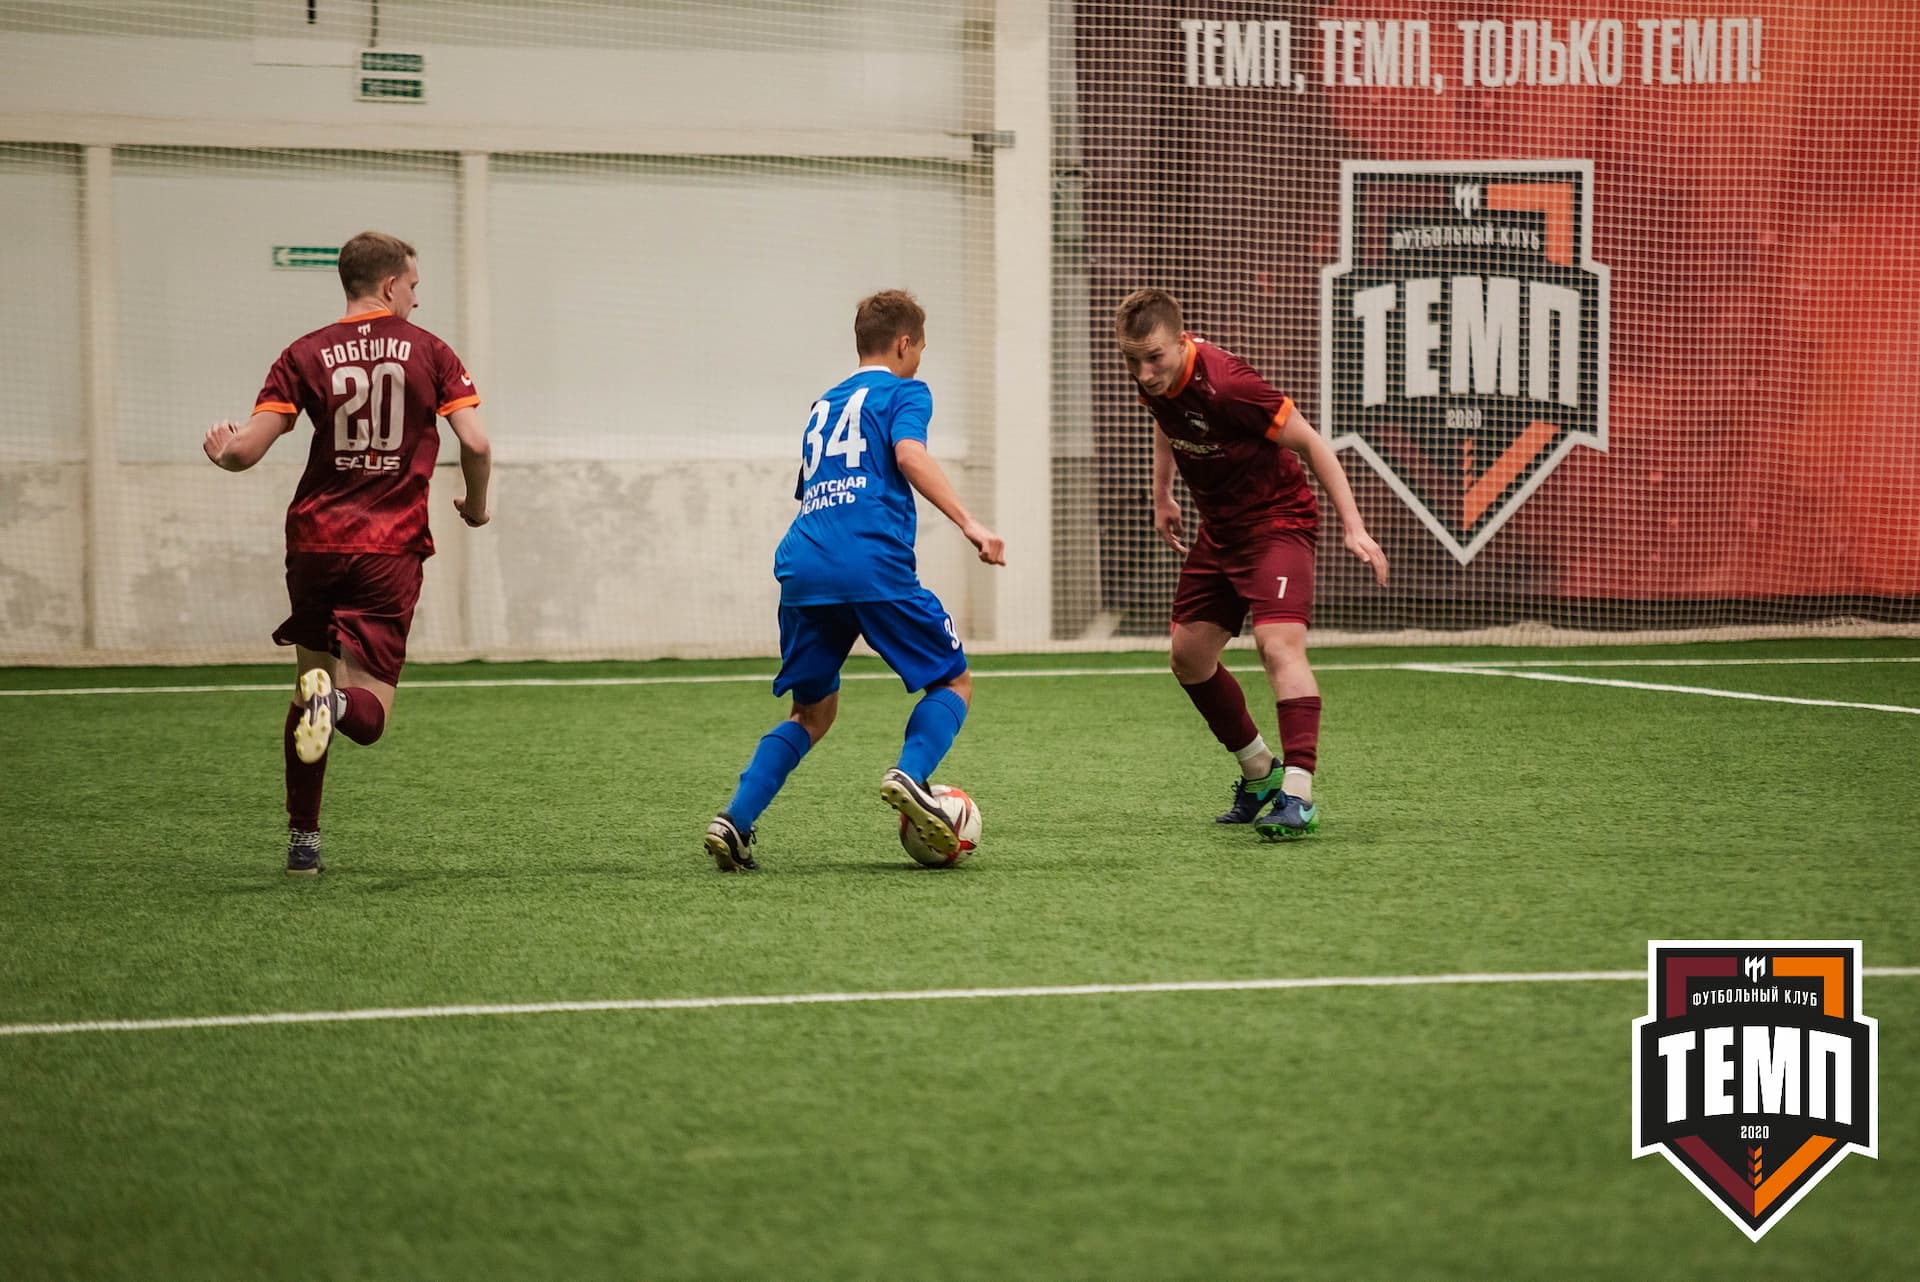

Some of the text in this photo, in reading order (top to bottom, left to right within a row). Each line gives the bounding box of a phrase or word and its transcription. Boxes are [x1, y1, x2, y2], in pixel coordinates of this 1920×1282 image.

[1181, 17, 1763, 95] ТЕМП, ТЕМП, ТОЛЬКО ТЕМП!
[1500, 228, 1540, 250] КЛУБ
[321, 337, 412, 368] БОБЕШКО
[1353, 275, 1580, 409] ТЕМП
[332, 361, 405, 451] 20
[1447, 409, 1482, 429] 2020
[802, 387, 870, 481] 34
[803, 476, 867, 503] КУТСКАЯ
[1276, 576, 1288, 599] 7
